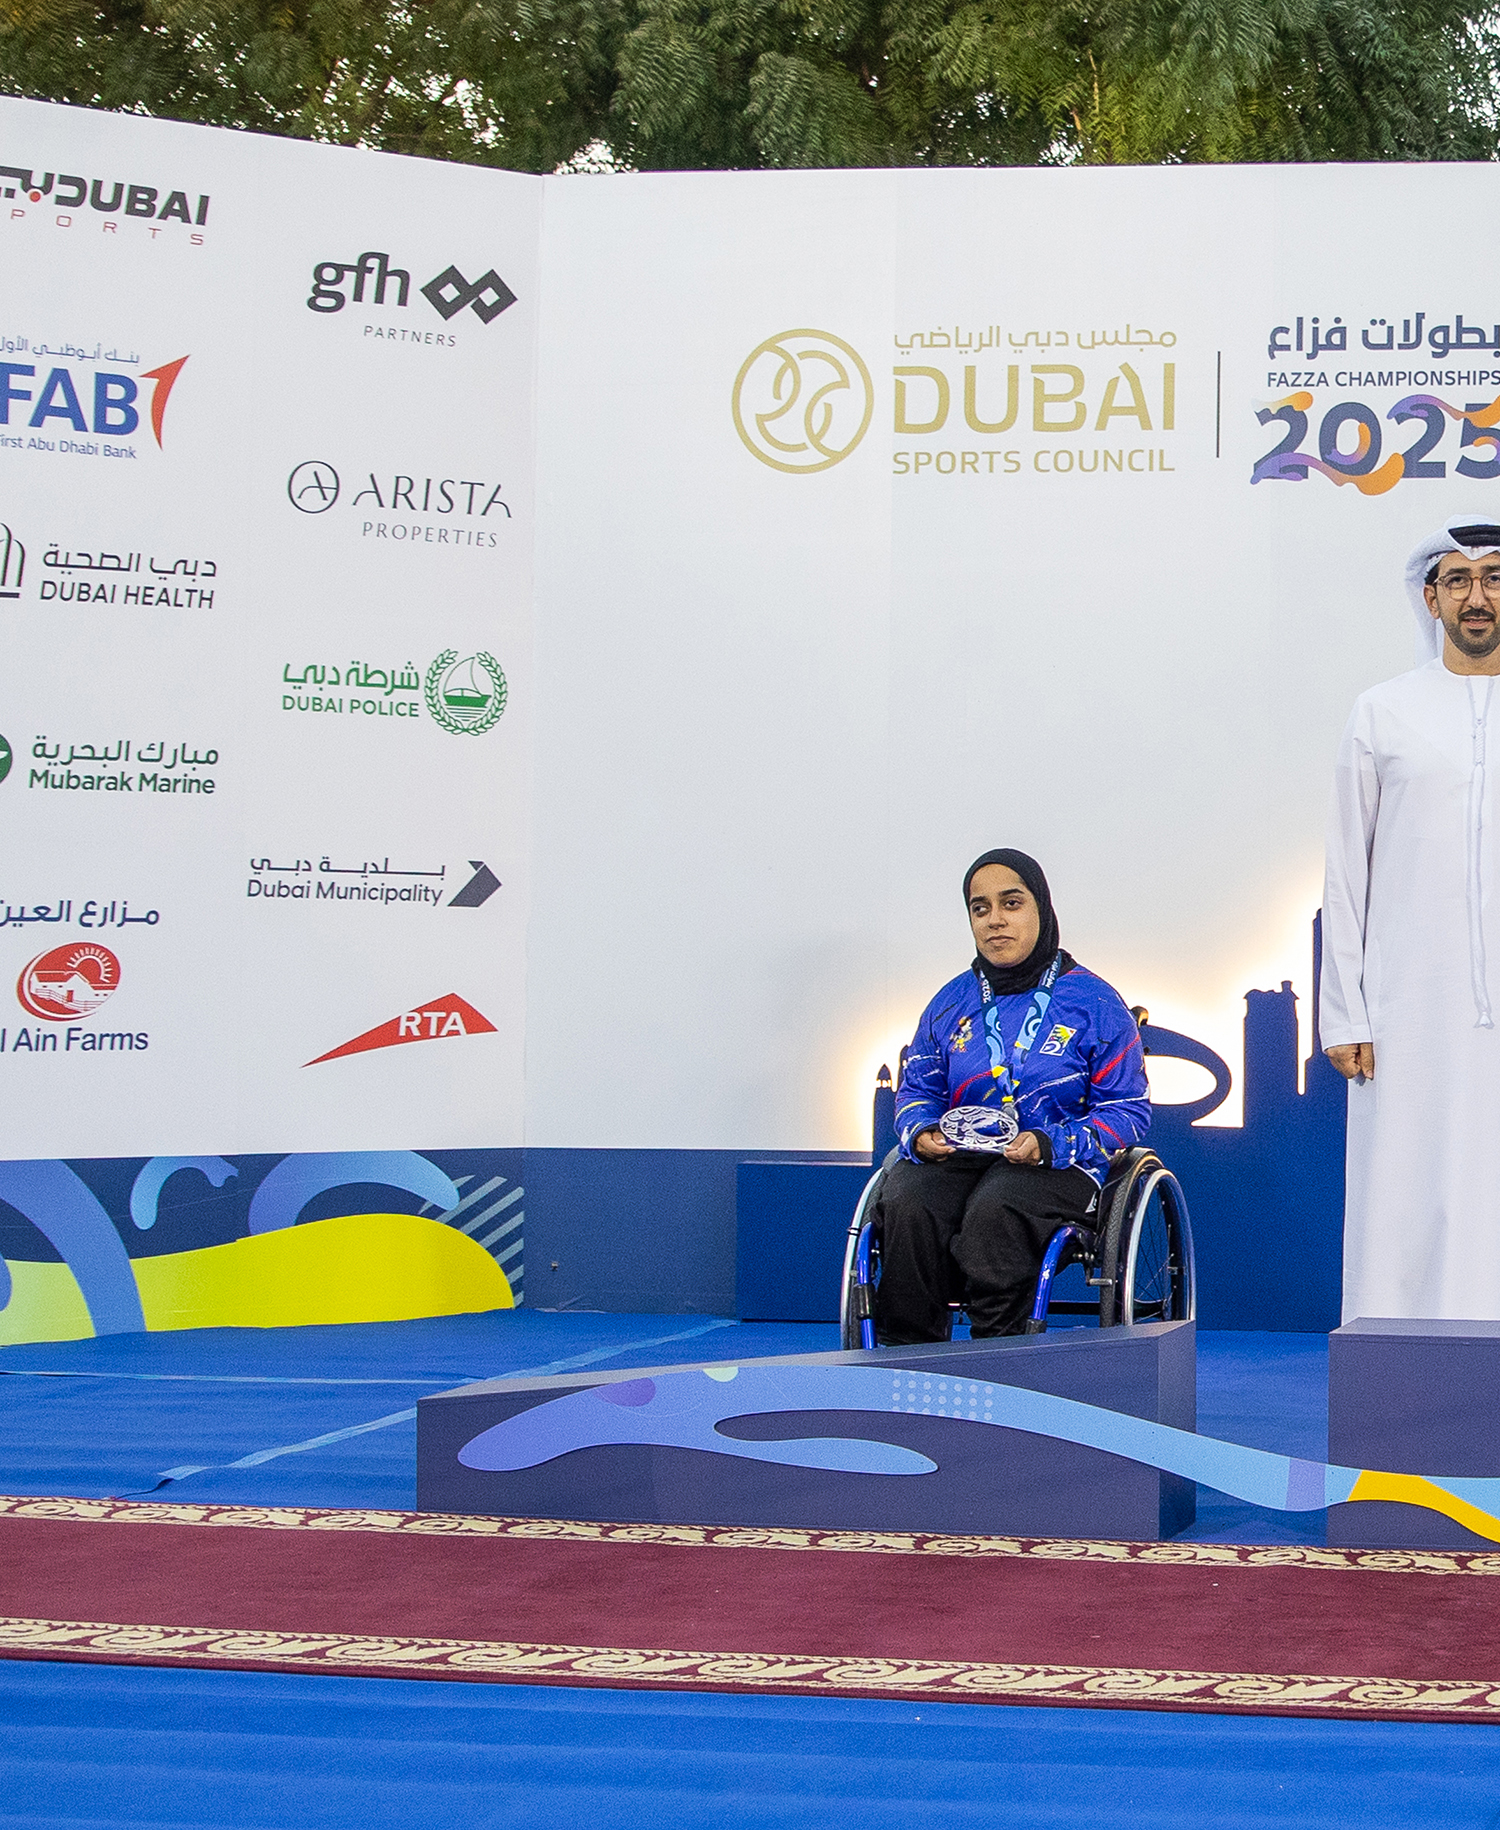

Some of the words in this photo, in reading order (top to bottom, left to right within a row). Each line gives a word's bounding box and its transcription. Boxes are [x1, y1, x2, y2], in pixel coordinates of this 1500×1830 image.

[54, 173, 210, 226] DUBAI
[307, 252, 410, 313] gfh
[364, 325, 455, 347] PARTNERS
[894, 326, 1000, 355] الرياضي
[1008, 331, 1069, 353] دبي
[1077, 324, 1177, 352] مجلس
[1268, 317, 1347, 360] فزاع
[1362, 312, 1500, 359] بطولات
[104, 348, 140, 367] بنك
[1268, 372, 1329, 387] FAZZA
[0, 361, 139, 436] FAB
[893, 362, 1175, 434] DUBAI
[27, 437, 55, 451] Abu
[59, 440, 98, 455] Dhabi
[103, 445, 136, 459] Bank
[893, 451, 1021, 474] SPORTS
[1034, 449, 1175, 473] COUNCIL
[353, 473, 511, 518] ARISTA
[363, 522, 497, 548] PROPERTIES
[43, 543, 141, 575] الصحية
[149, 558, 216, 582] دبي
[40, 580, 116, 603] DUBAI
[124, 585, 214, 609] HEALTH
[283, 663, 340, 691] دبي
[346, 661, 419, 696] شرطة
[283, 695, 343, 713] DUBAI
[350, 699, 419, 717] POLICE
[32, 735, 130, 768] البحرية
[137, 742, 218, 771] مبارك
[29, 765, 133, 791] Mubarak
[138, 773, 215, 794] Marine
[250, 858, 312, 876] دبي
[318, 856, 446, 881] بلدية
[247, 879, 311, 898] Dubai
[316, 881, 444, 907] Municipality
[79, 901, 159, 927] مزارع
[398, 1012, 467, 1036] RTA
[13, 1028, 57, 1052] Ain
[65, 1027, 148, 1051] Farms
